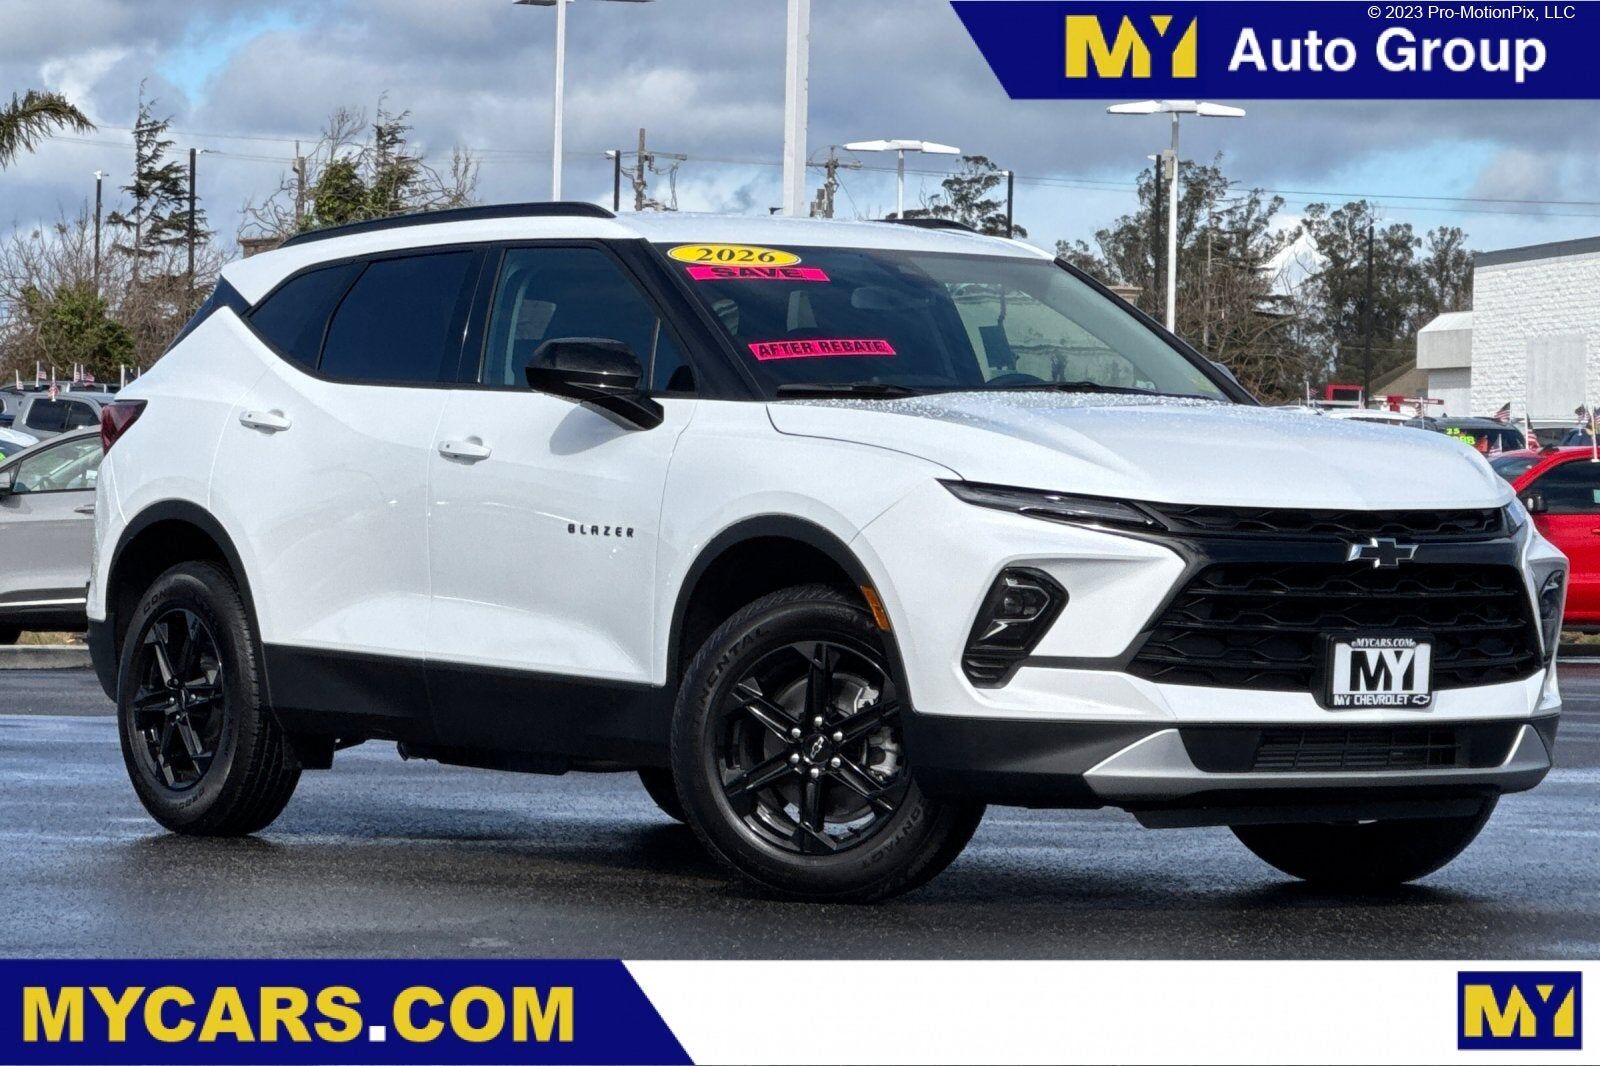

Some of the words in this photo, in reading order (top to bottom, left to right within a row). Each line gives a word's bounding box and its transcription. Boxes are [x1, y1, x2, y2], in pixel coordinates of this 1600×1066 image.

[695, 247, 776, 263] 2026
[710, 267, 804, 279] SAVE
[757, 342, 815, 358] AFTER
[818, 340, 886, 355] REBATE
[567, 523, 634, 538] BLAZER
[1349, 650, 1415, 691] MY
[1333, 694, 1351, 706] MY
[1354, 694, 1410, 706] CHEVROLET
